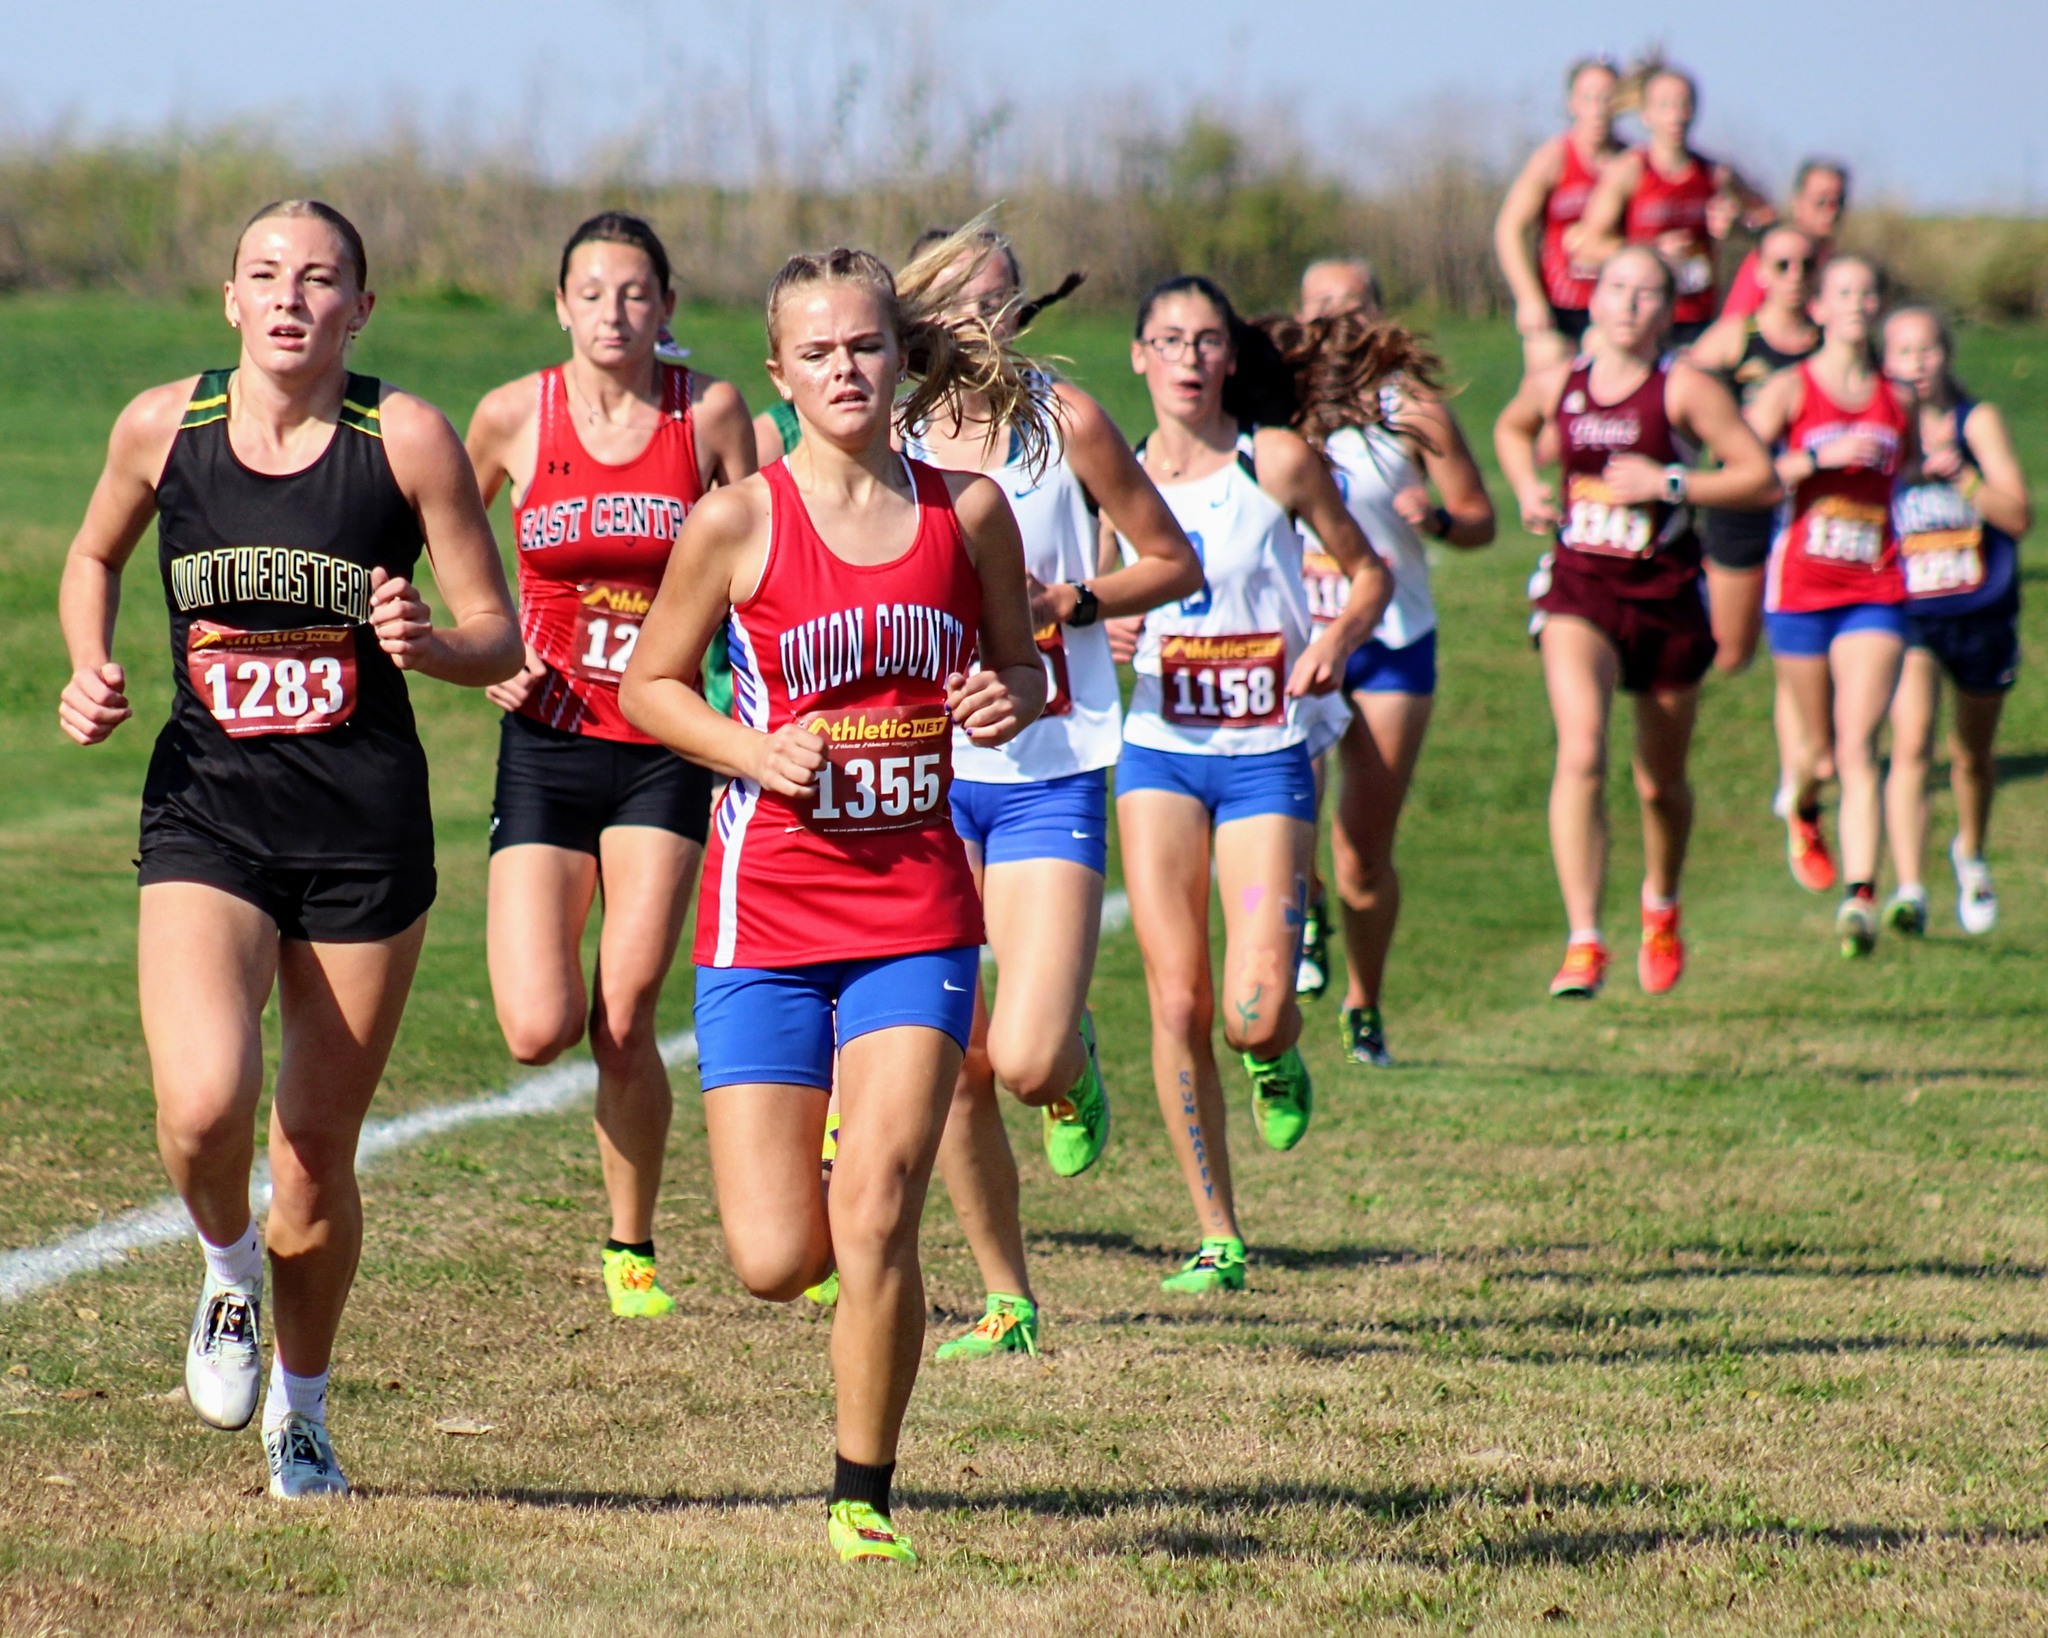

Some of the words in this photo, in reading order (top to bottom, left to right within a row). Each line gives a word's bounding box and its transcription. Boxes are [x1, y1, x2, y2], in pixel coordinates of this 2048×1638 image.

[520, 499, 588, 551] EAST
[591, 492, 693, 541] CENTR
[582, 586, 649, 614] Athle
[581, 618, 640, 673] 12
[779, 606, 864, 701] UNION
[875, 603, 964, 690] COUNTY
[204, 656, 344, 720] 1283
[1173, 666, 1276, 718] 1158
[812, 753, 941, 820] 1355
[1178, 1070, 1196, 1115] RUN
[1188, 1125, 1214, 1200] HAPPY
